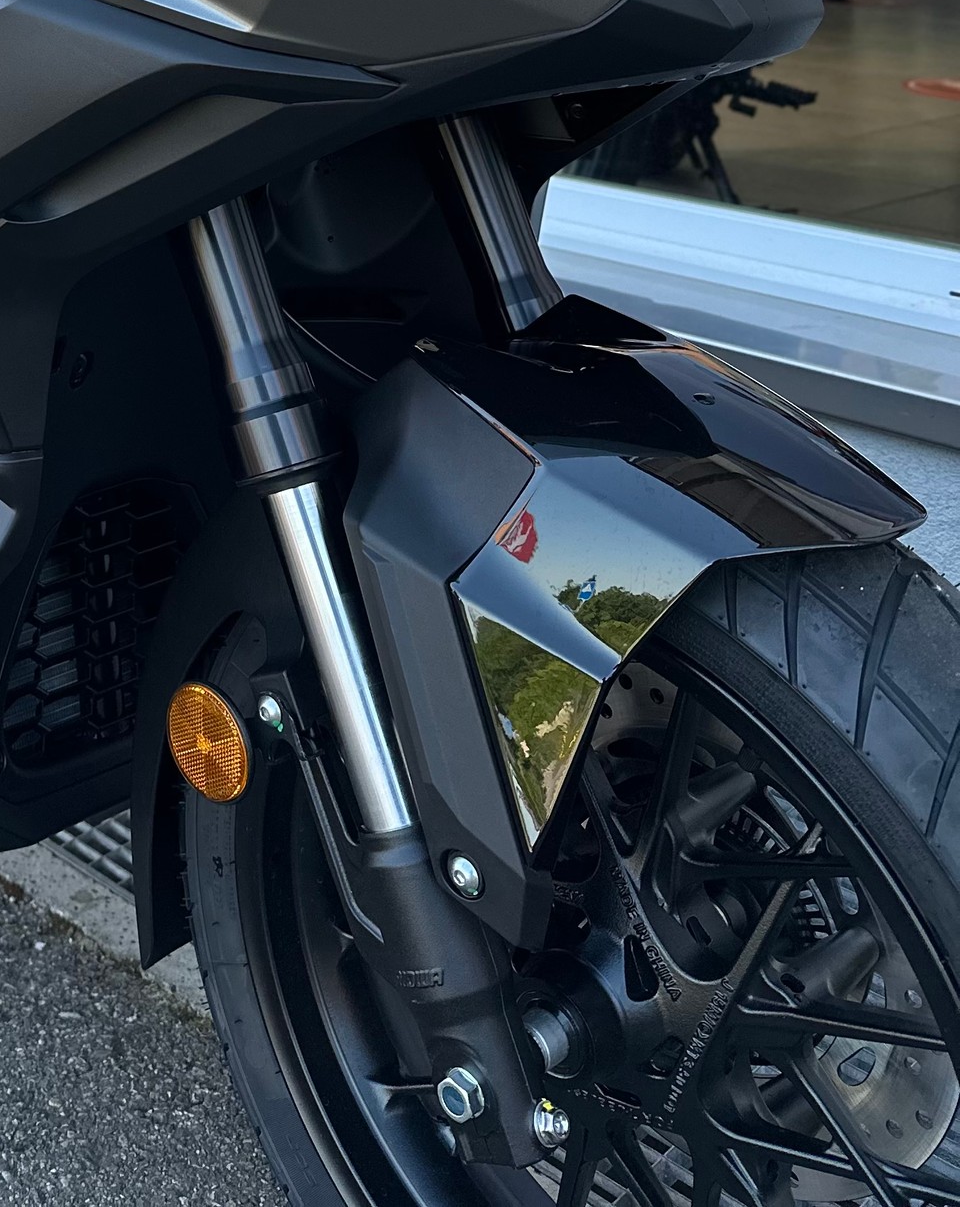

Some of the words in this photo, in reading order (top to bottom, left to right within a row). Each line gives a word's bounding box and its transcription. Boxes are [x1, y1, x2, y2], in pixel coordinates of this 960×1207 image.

[610, 864, 639, 921] MADE
[633, 922, 651, 943] IN
[645, 945, 682, 1002] CHINA
